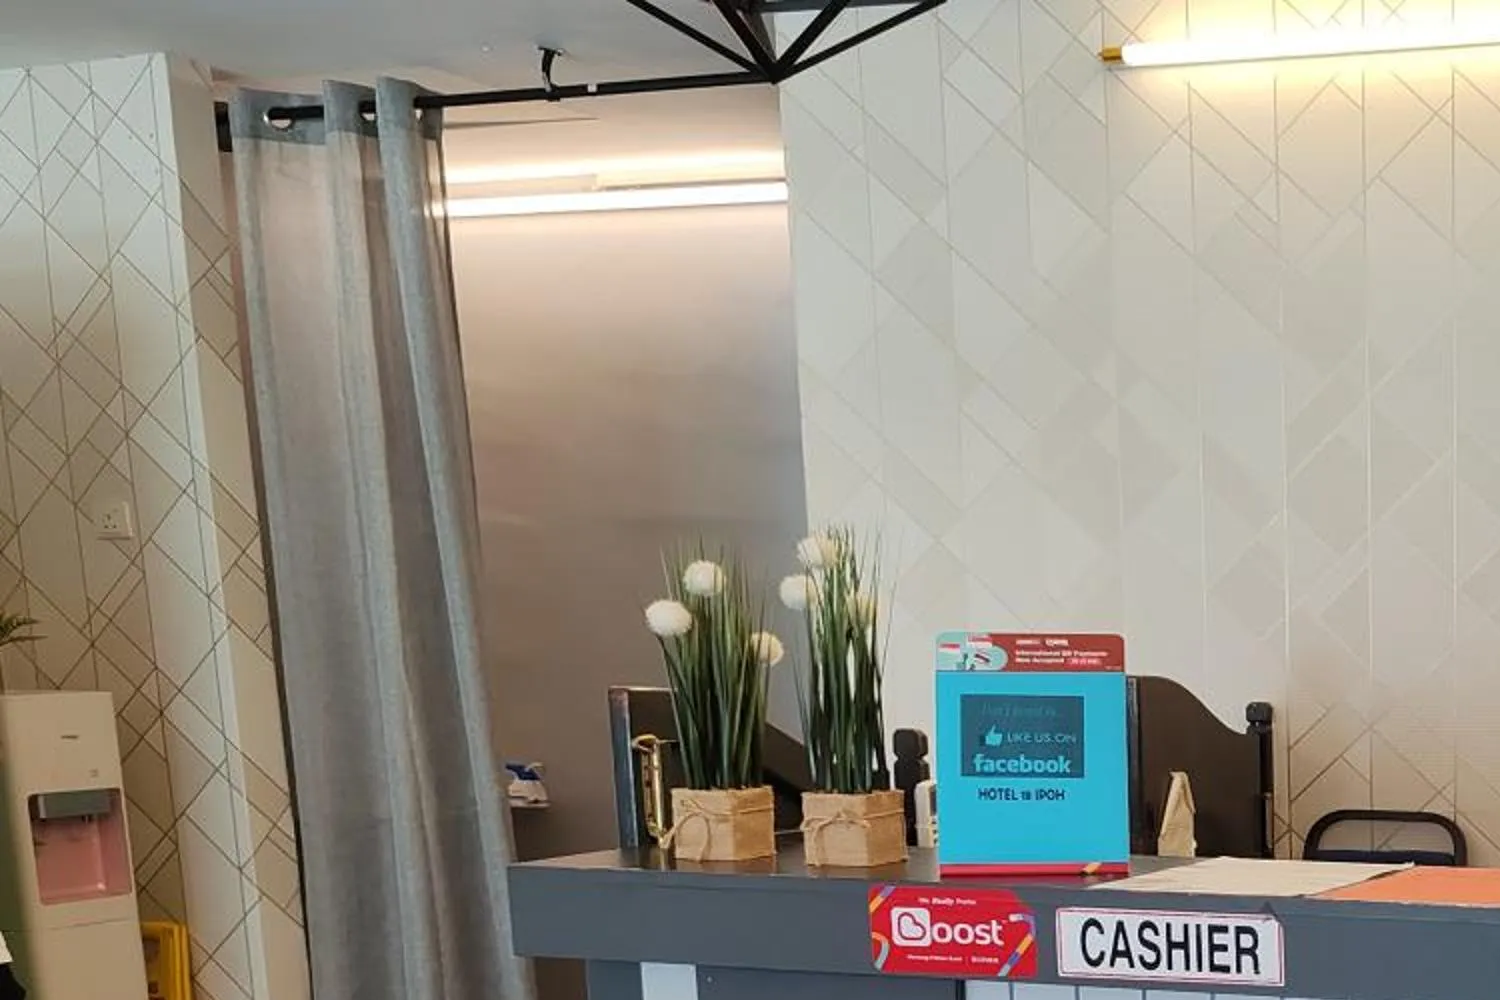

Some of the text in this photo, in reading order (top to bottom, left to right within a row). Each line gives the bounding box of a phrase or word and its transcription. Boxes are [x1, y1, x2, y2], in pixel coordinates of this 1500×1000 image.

[1007, 732, 1032, 743] LIKE
[1035, 732, 1051, 743] US
[973, 753, 1072, 773] facebook
[977, 787, 1018, 801] HOTEL
[1035, 788, 1066, 801] IPOH
[890, 907, 1005, 947] Boost
[1080, 918, 1260, 975] CASHIER
